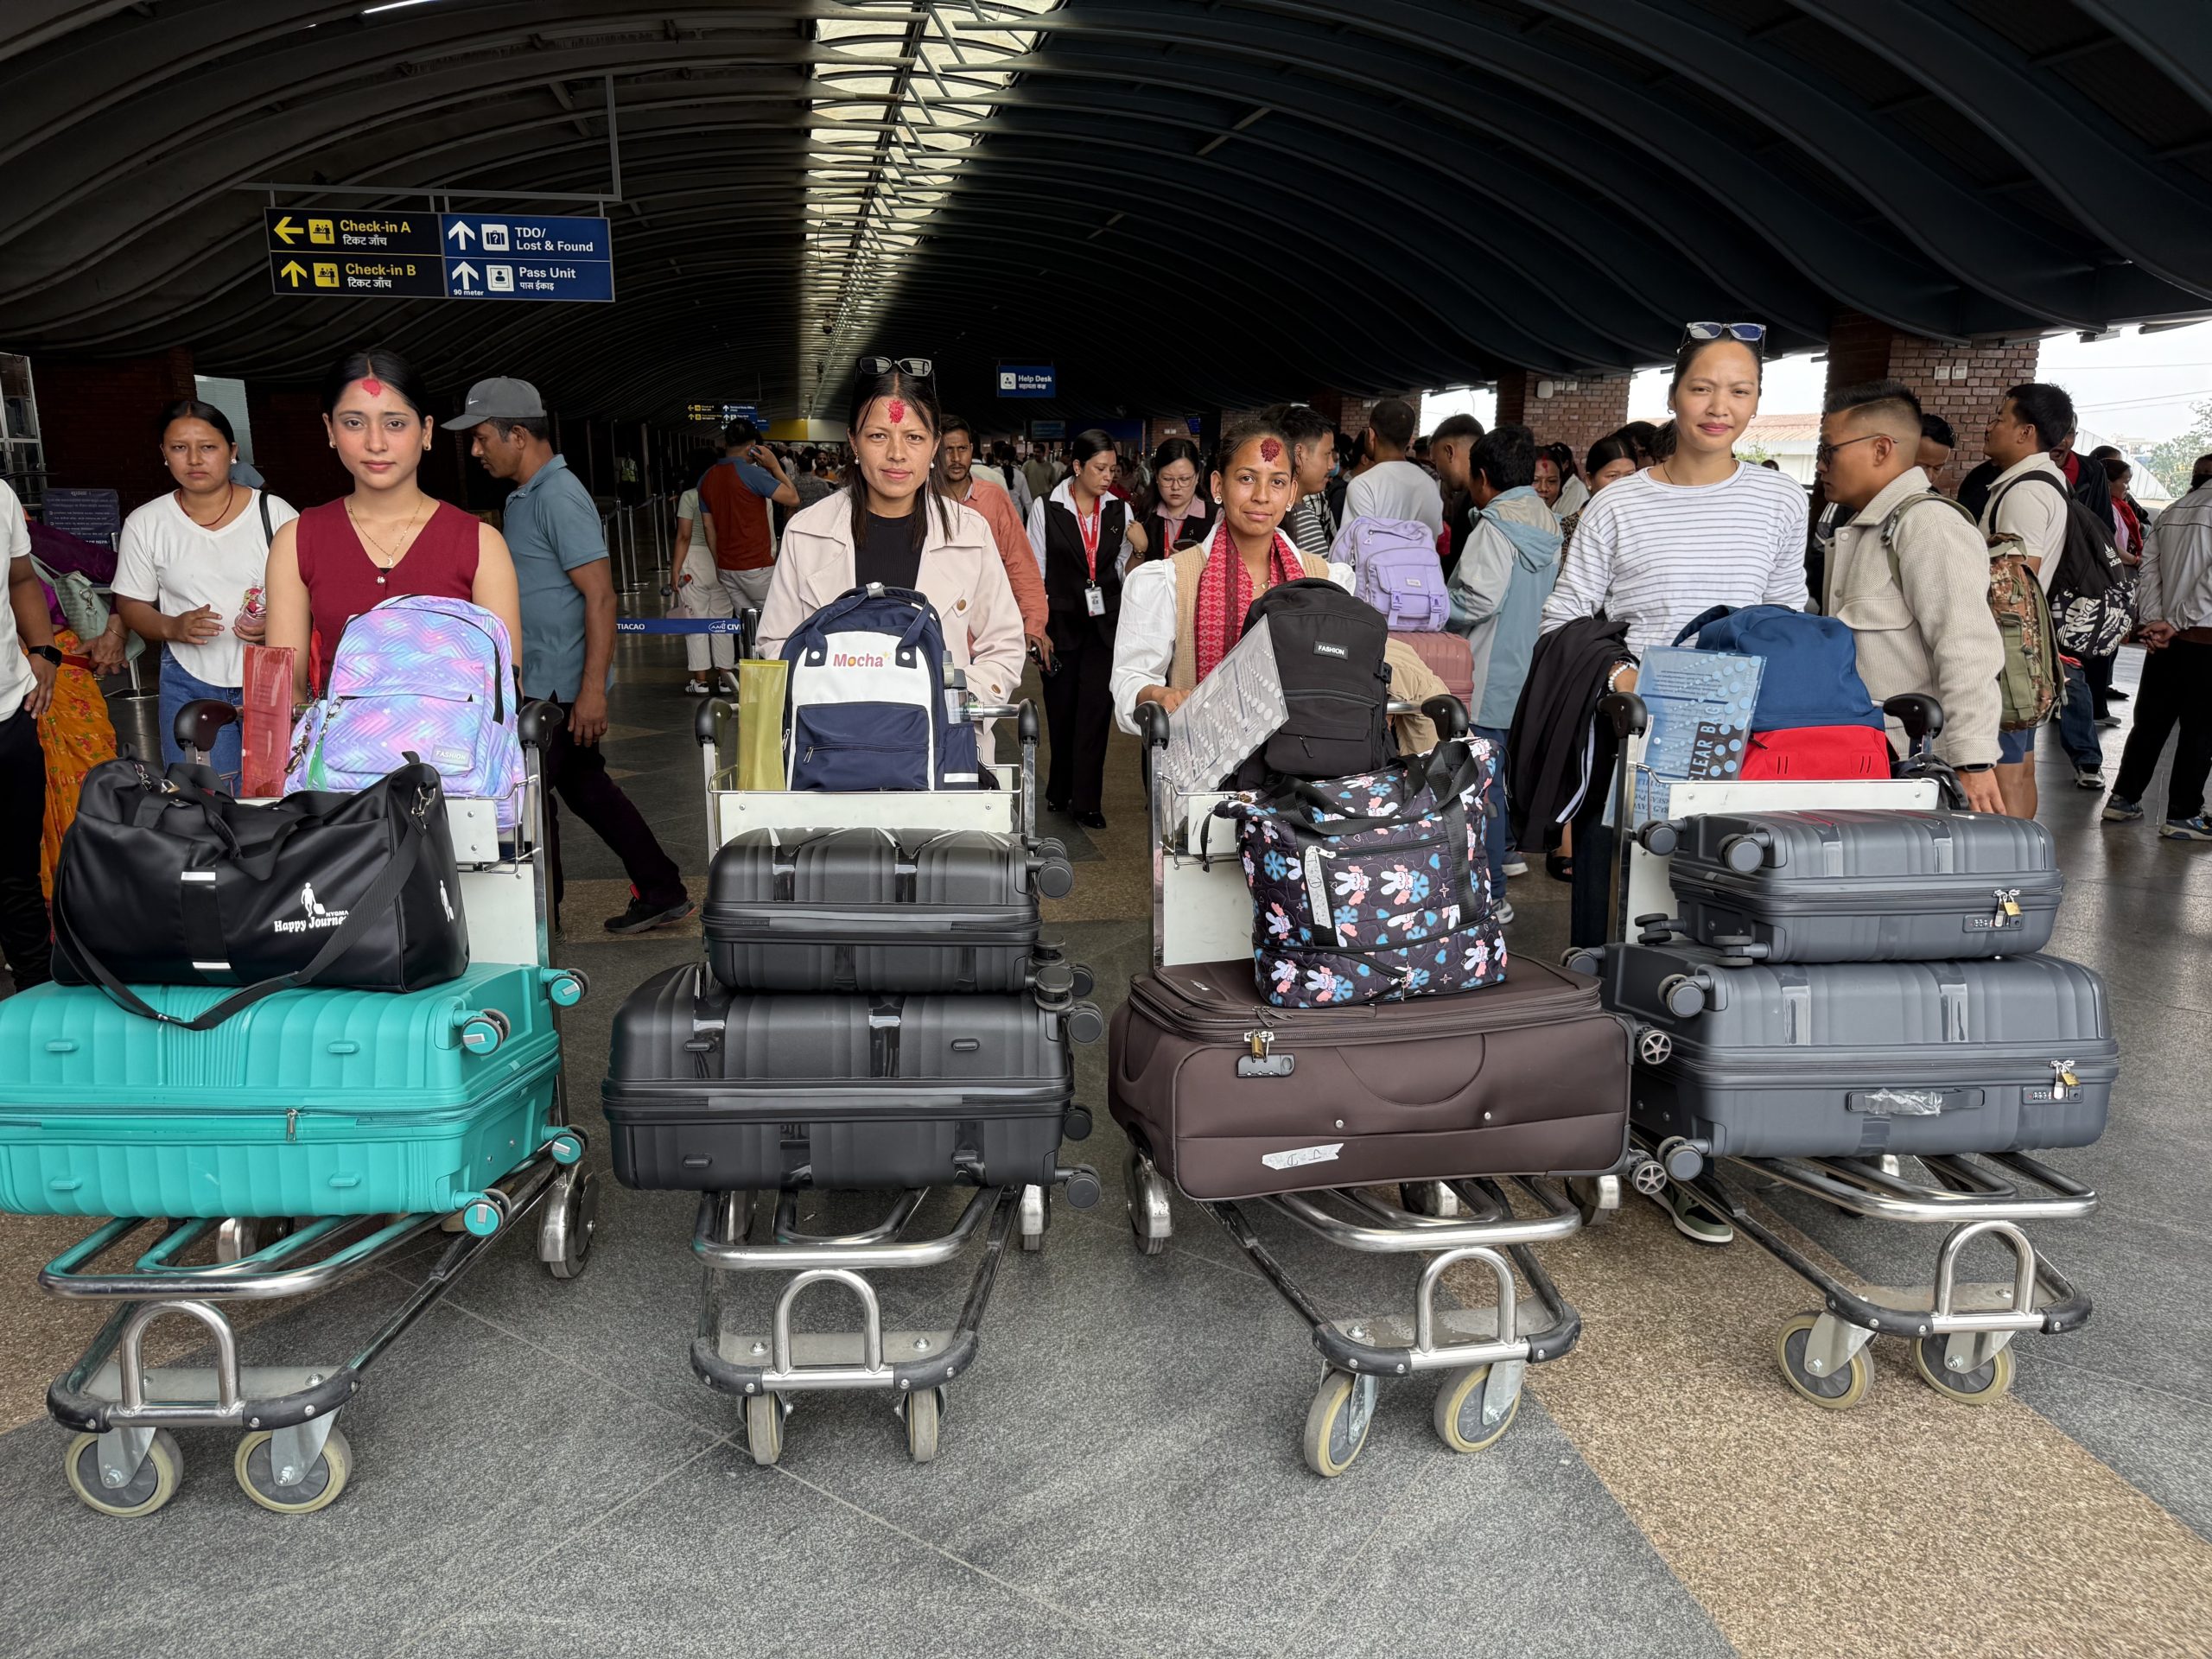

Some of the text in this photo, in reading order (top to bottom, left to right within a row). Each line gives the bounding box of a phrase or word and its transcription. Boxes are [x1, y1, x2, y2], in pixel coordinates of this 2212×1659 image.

[340, 219, 411, 233] Check-in A
[515, 226, 546, 238] TDO/
[342, 234, 367, 245] टिकट
[516, 240, 594, 252] Lost & Found
[346, 263, 416, 276] Check-in B
[518, 266, 576, 279] Pass Unit
[347, 276, 372, 288] टिकट
[1018, 374, 1052, 384] Help Desk
[1318, 645, 1344, 656] FASHION
[833, 652, 884, 668] Mocha
[1218, 728, 1234, 754] BAG
[435, 750, 466, 760] FASHION
[273, 916, 346, 933] Happy Journe
